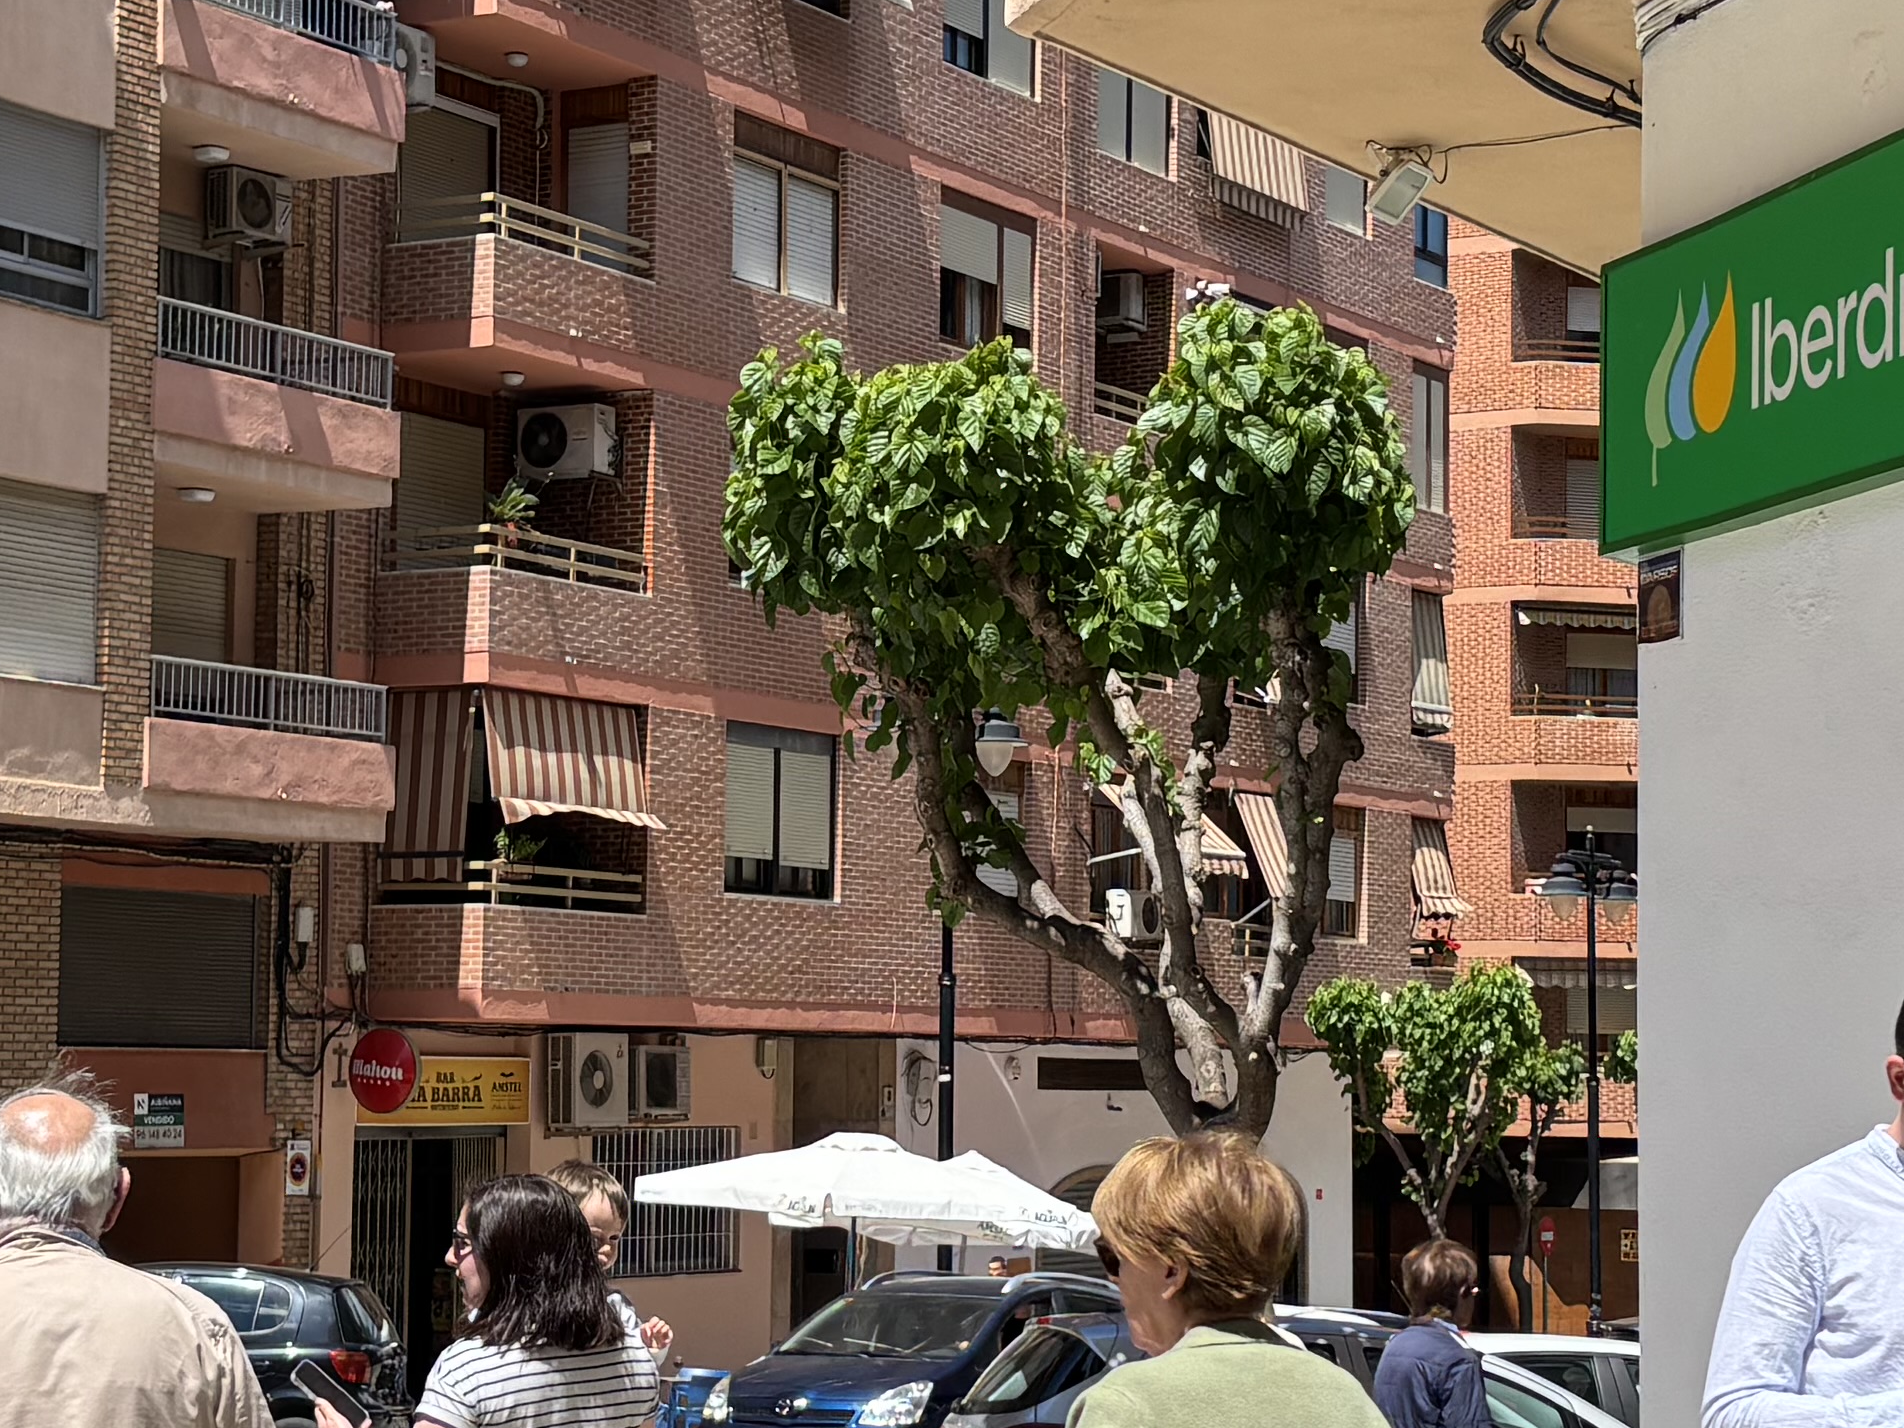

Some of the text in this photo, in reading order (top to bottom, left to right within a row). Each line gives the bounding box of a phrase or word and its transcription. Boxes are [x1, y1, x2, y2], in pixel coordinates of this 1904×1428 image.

[436, 1071, 456, 1084] BAR
[491, 1082, 522, 1093] AMSTEL
[409, 1085, 428, 1103] A
[431, 1085, 483, 1103] BARRA
[143, 1115, 175, 1124] VENDIDO
